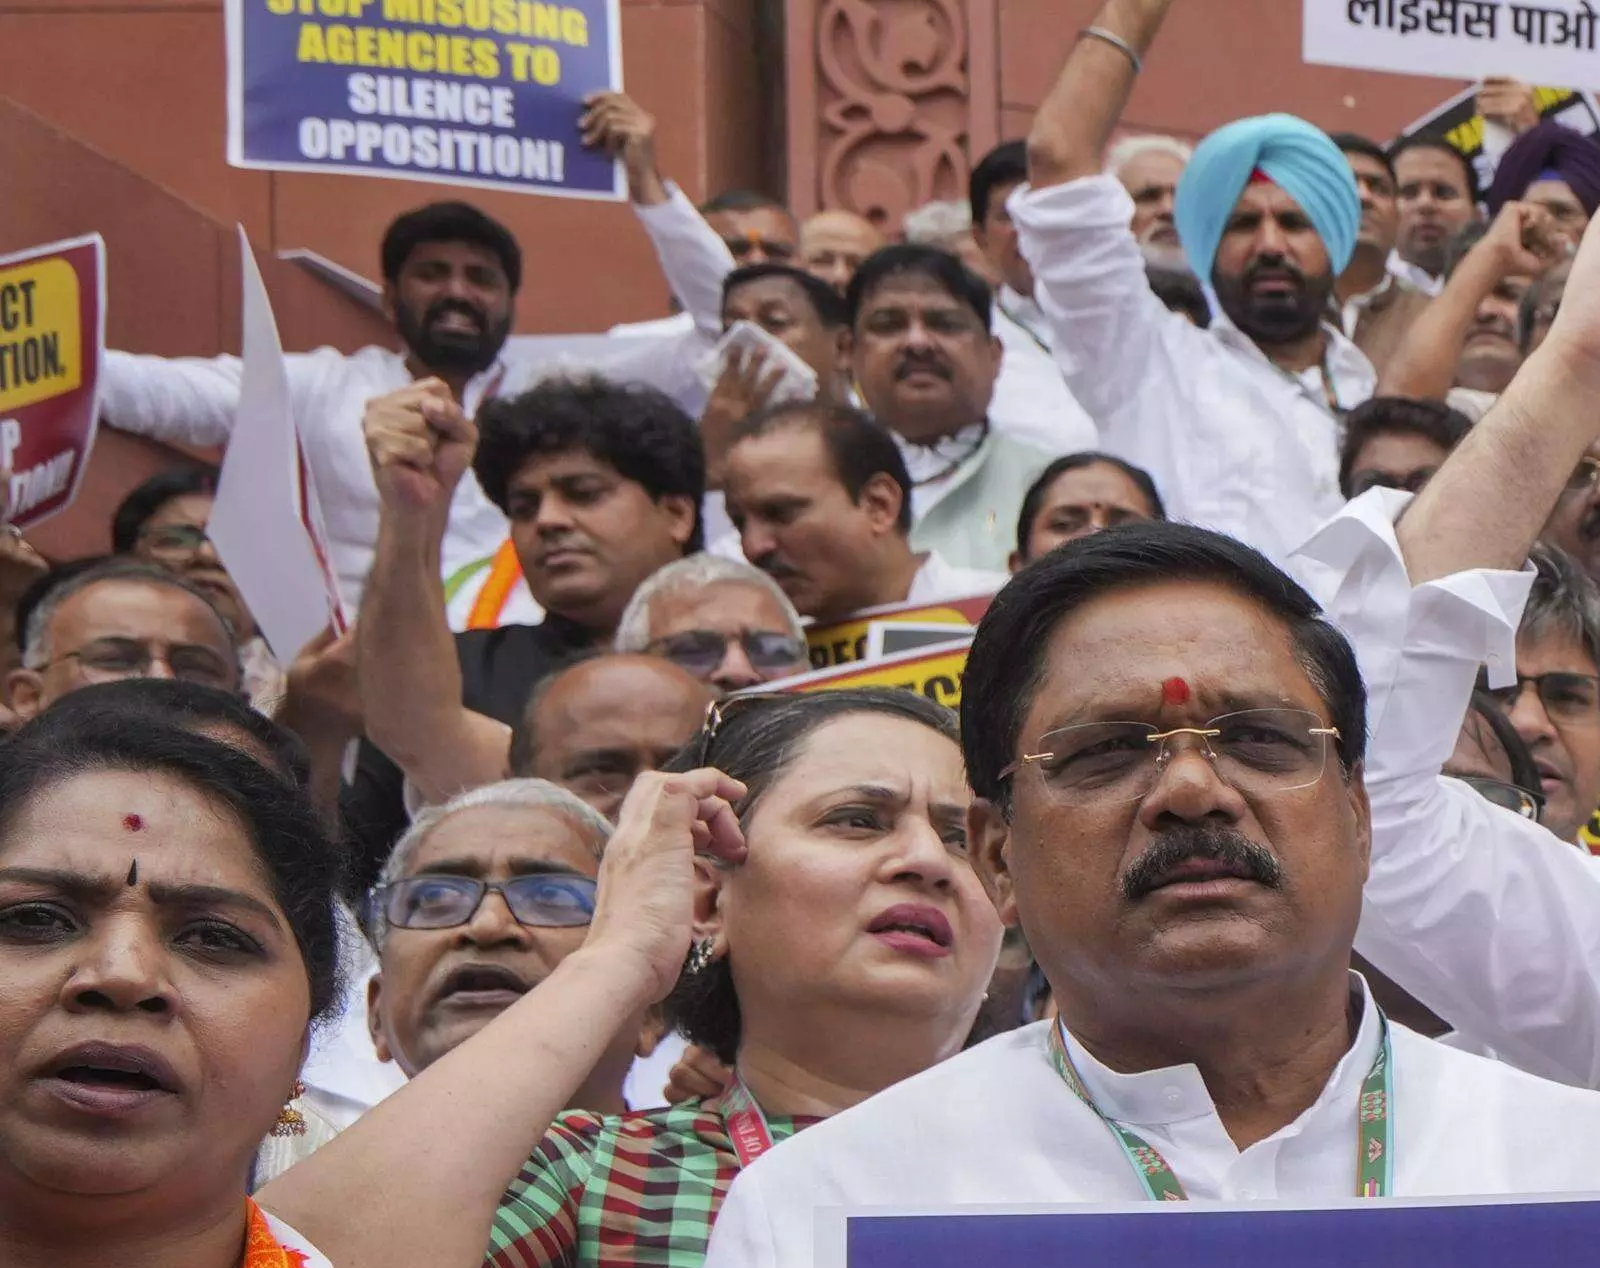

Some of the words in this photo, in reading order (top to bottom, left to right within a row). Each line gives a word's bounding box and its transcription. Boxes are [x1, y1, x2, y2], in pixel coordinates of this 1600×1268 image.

[297, 22, 500, 79] AGENCIES
[505, 43, 561, 86] TO
[347, 72, 516, 128] SILENCE
[298, 117, 566, 182] OPPOSITION!
